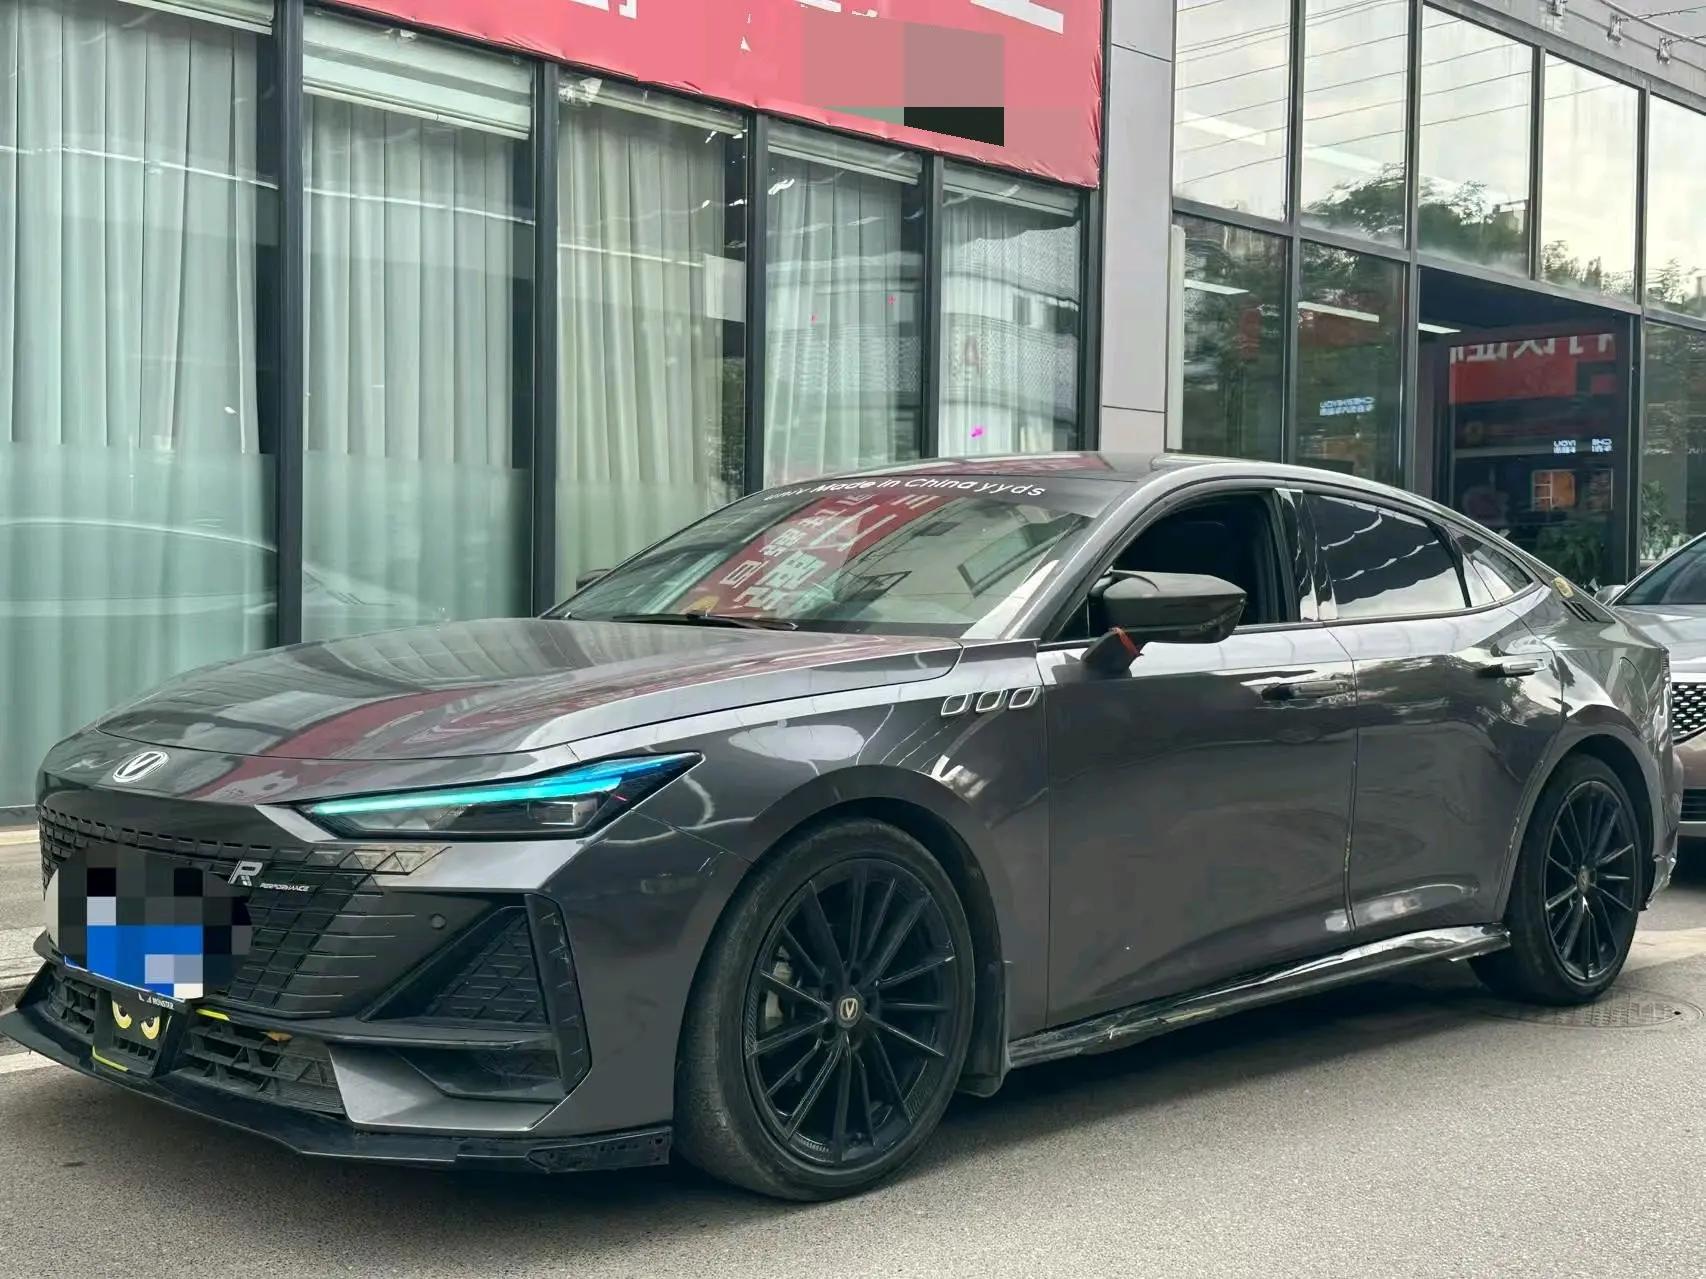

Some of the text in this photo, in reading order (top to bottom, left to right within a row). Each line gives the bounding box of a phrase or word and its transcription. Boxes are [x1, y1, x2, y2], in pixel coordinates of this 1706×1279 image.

[810, 480, 876, 493] Made
[904, 478, 979, 489] China
[974, 482, 1047, 496] yyds
